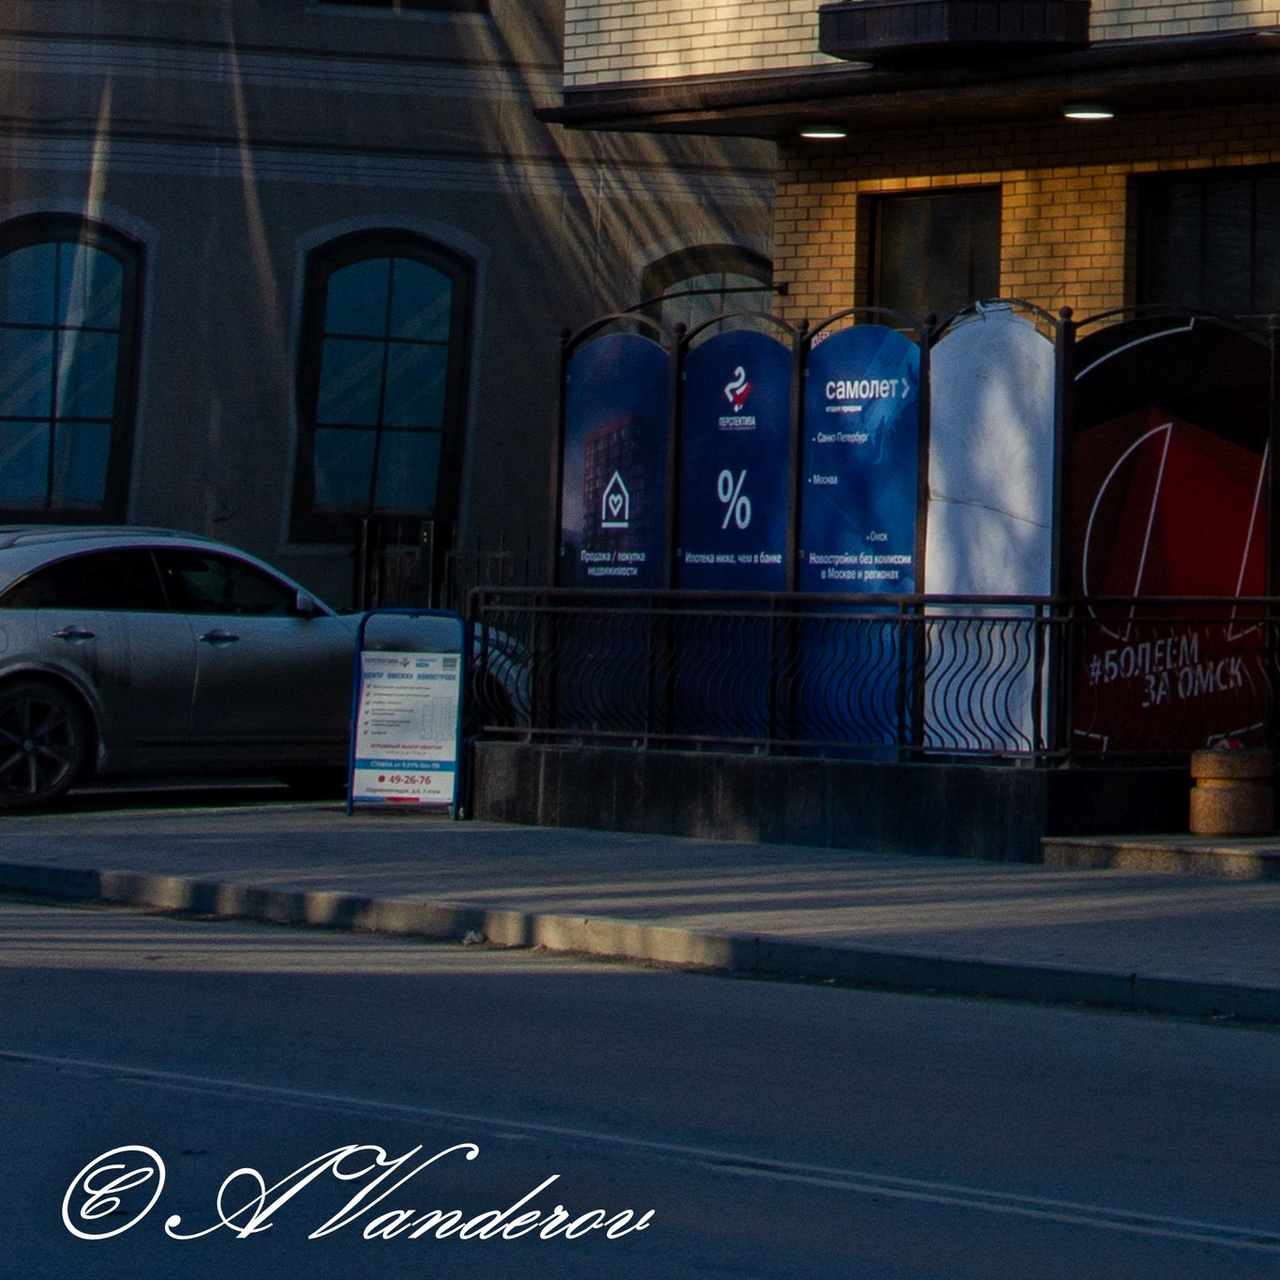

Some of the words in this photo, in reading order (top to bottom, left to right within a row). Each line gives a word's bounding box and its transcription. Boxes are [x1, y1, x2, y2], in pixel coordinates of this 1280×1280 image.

[825, 378, 900, 400] самолет
[816, 432, 869, 445] Санкт-Петербург
[812, 474, 839, 485] Москва
[717, 469, 751, 530] %
[580, 549, 611, 564] Продажа
[617, 552, 646, 565] покупка
[684, 551, 715, 564] Ипотека
[759, 550, 782, 565] банке
[809, 551, 858, 567] Новостройки
[859, 551, 873, 565] без
[874, 554, 912, 566] комиссии
[587, 566, 639, 577] недвижимости
[827, 567, 857, 580] Москве
[863, 569, 900, 582] регионах
[1089, 632, 1199, 687] #БОЛЕЕМ
[1141, 671, 1171, 708] ЗА
[1177, 656, 1244, 700] ОМСК
[388, 774, 433, 786] 49-26-76
